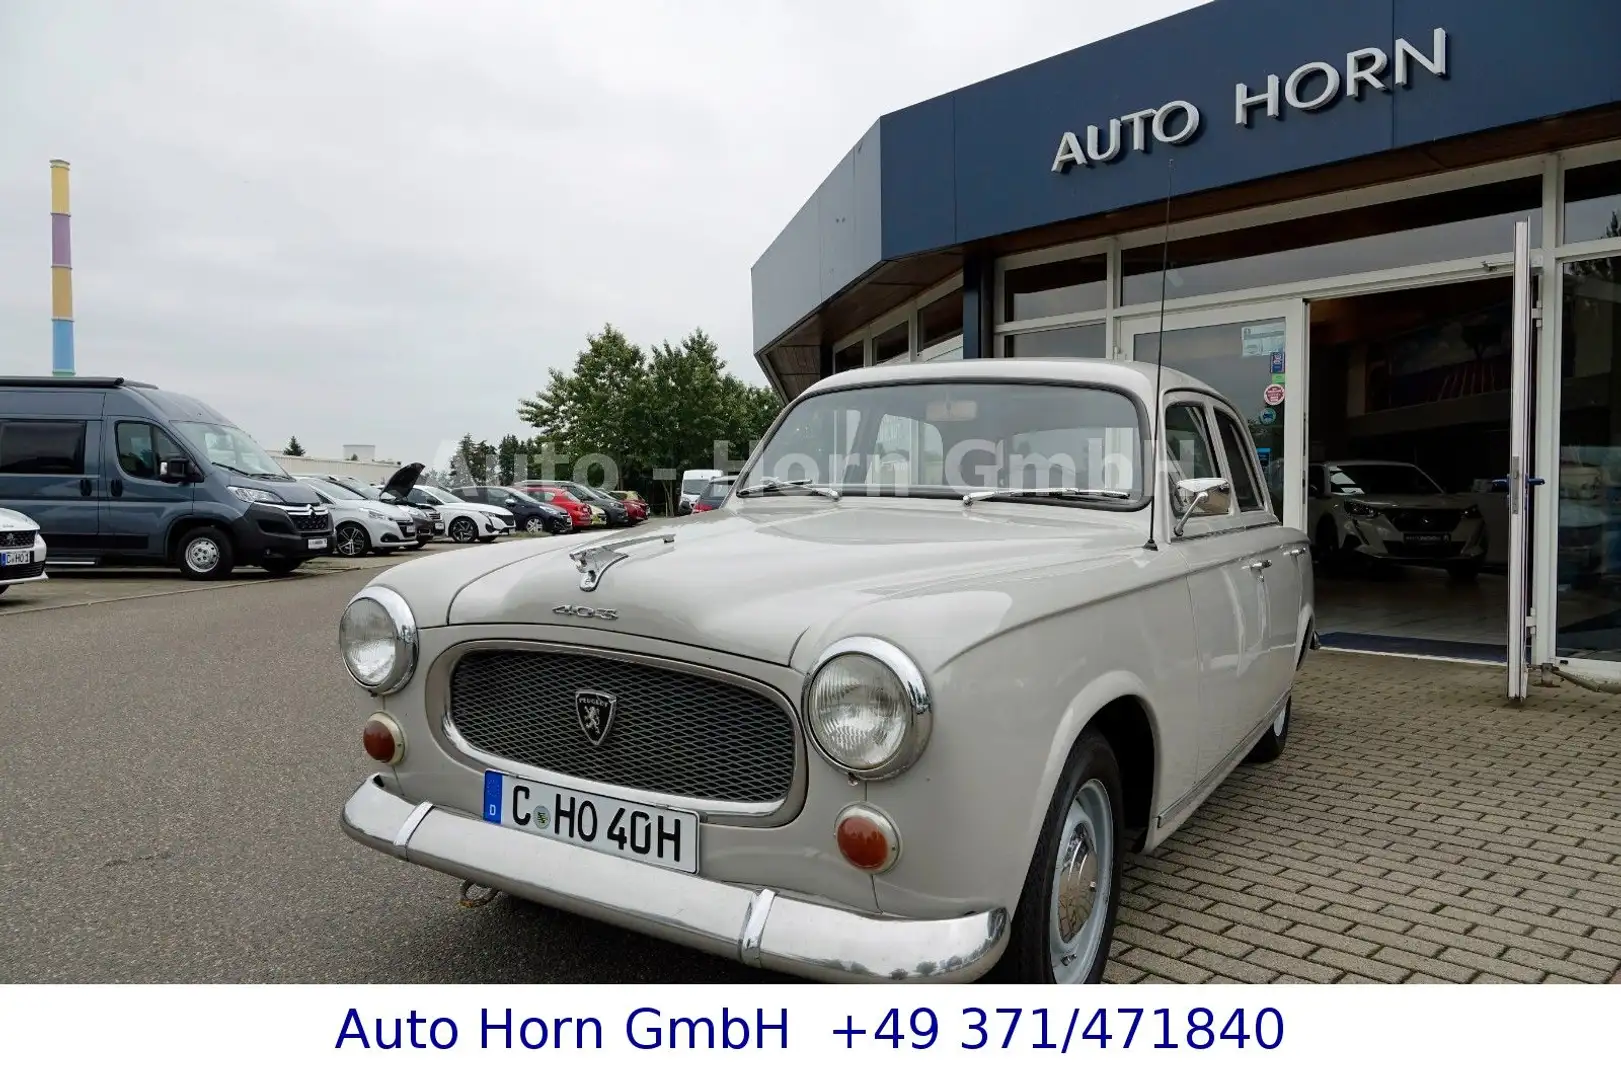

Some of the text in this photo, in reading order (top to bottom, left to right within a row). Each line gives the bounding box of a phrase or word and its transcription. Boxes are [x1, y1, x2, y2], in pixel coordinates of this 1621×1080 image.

[1051, 27, 1447, 173] AUTO HORN
[489, 804, 497, 816] D
[512, 785, 681, 862] C HO 40H
